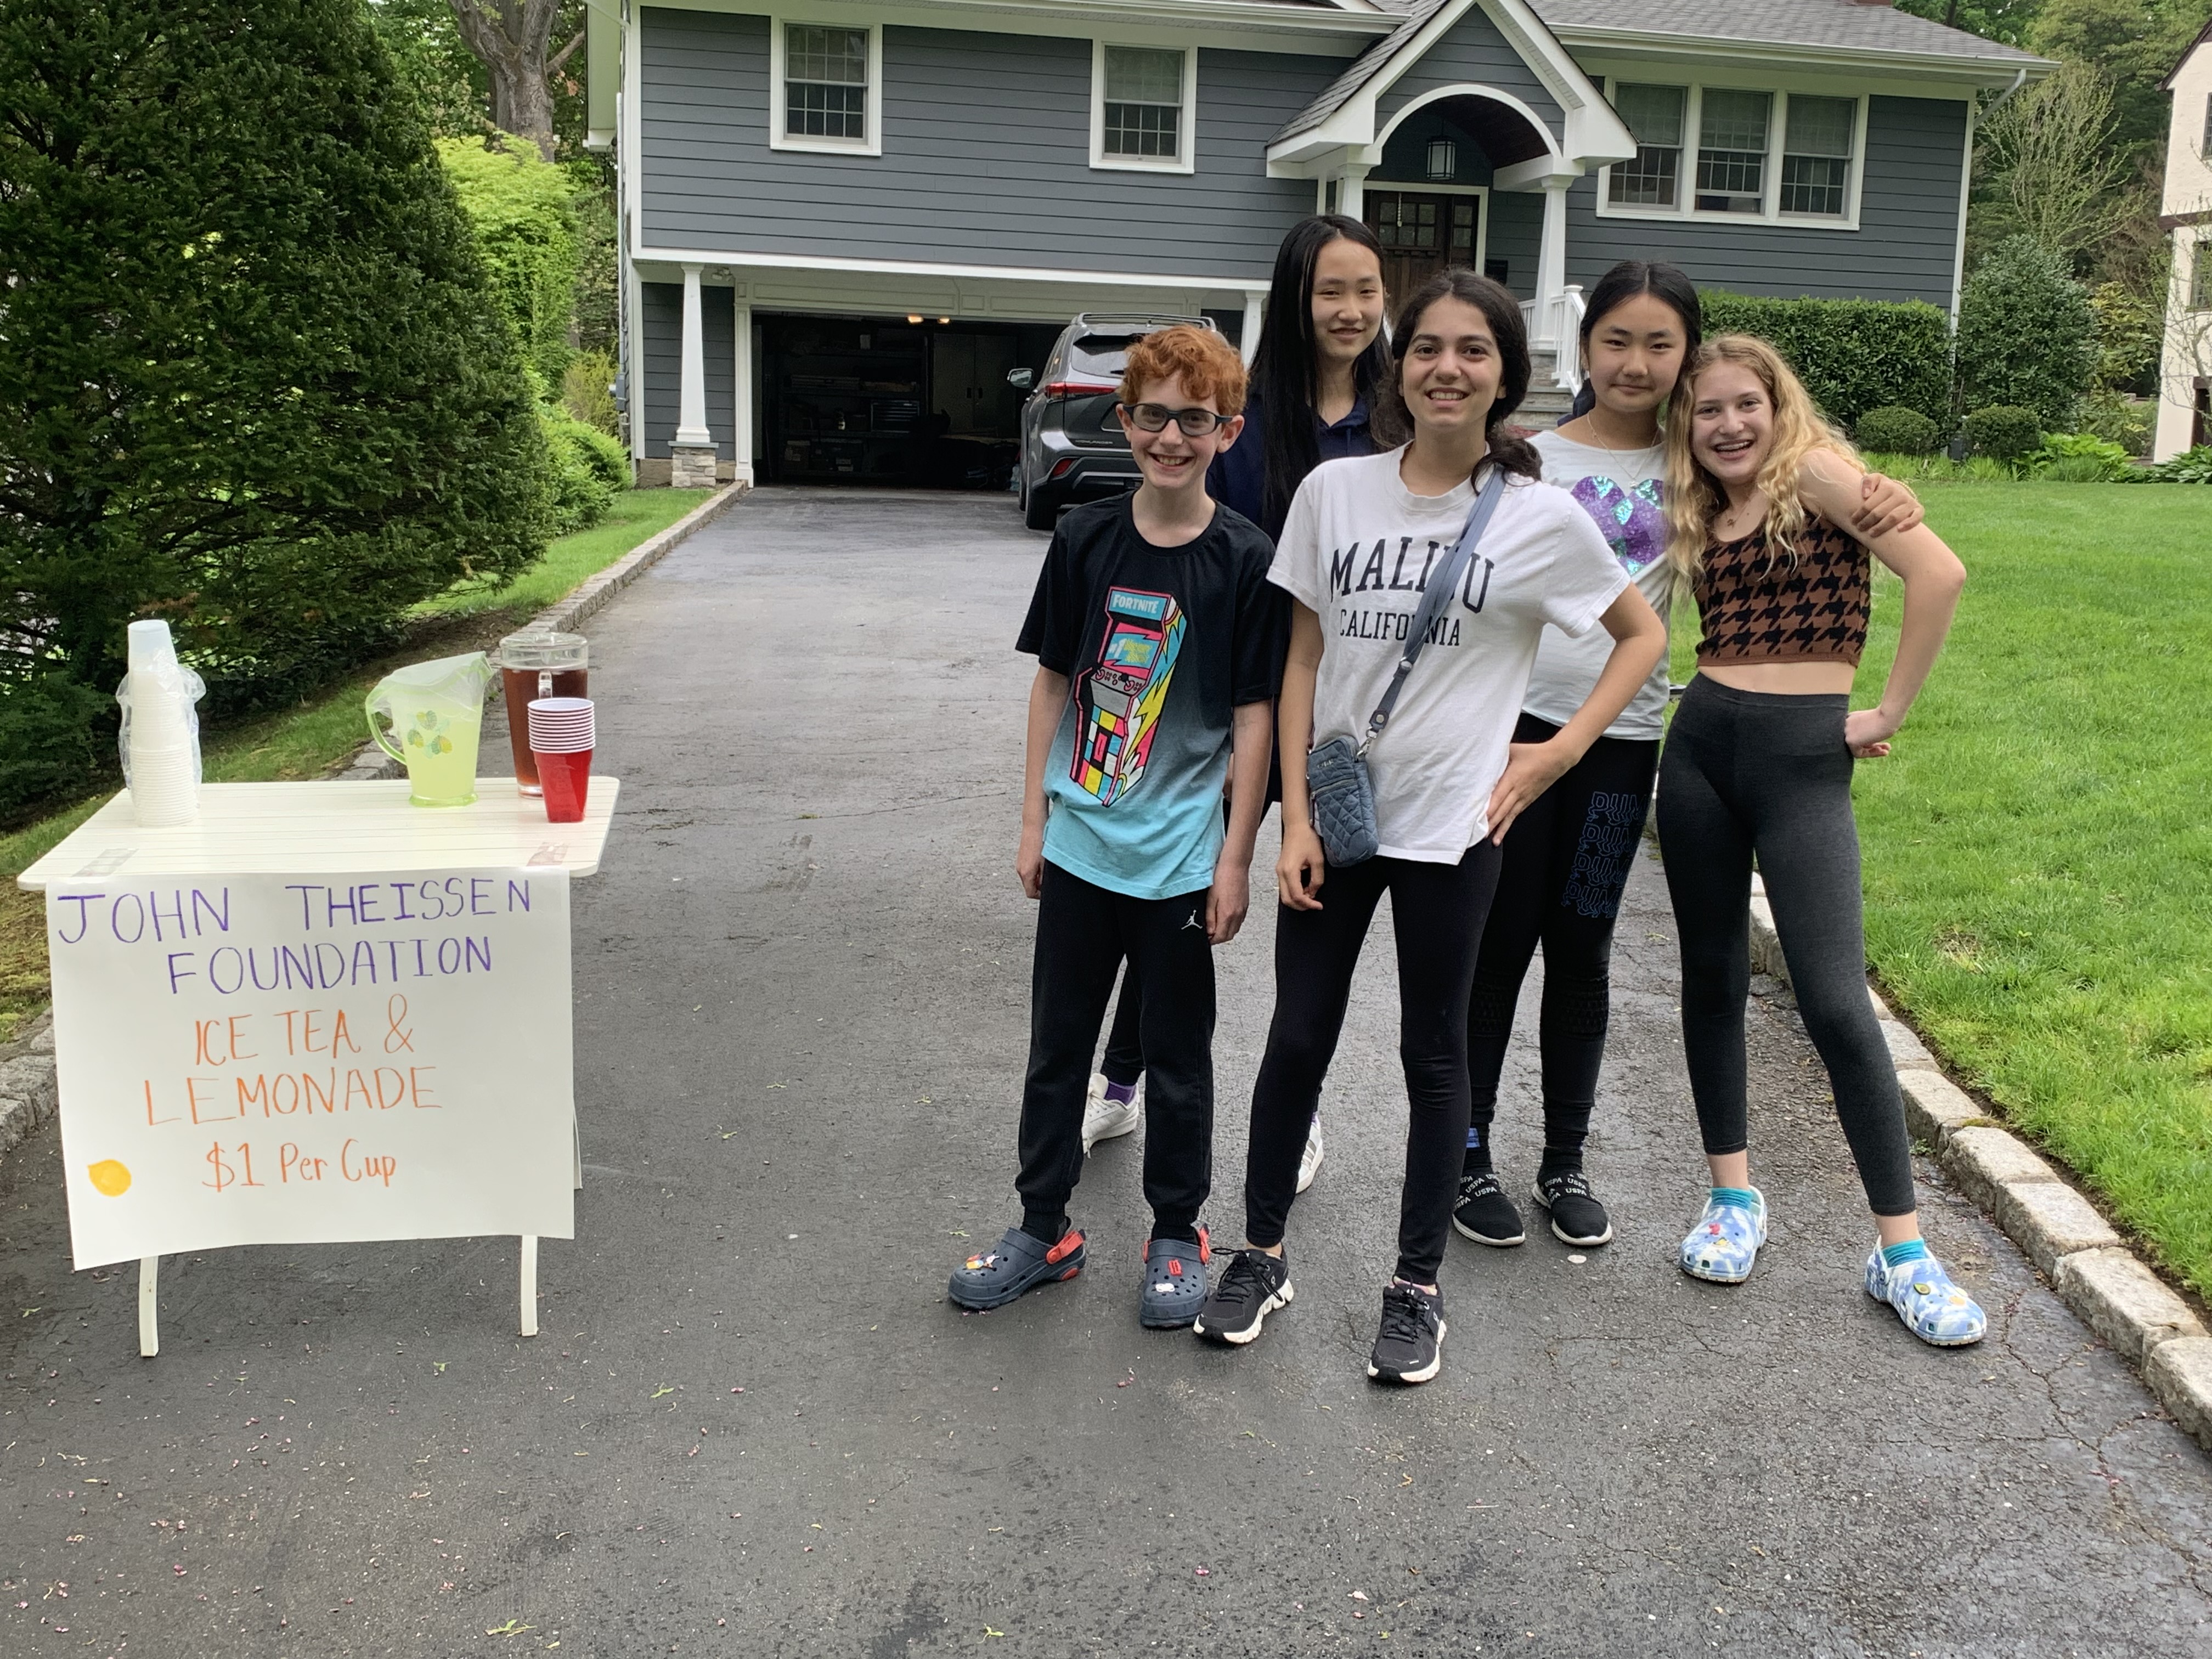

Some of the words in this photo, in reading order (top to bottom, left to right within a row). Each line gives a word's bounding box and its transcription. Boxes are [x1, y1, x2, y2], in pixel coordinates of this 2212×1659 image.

[1330, 536, 1494, 614] MALIU
[1112, 594, 1159, 614] FORTNITE
[1340, 609, 1460, 646] CALIFONIA
[57, 887, 229, 944] JOHN
[285, 878, 531, 930] THEISSEN
[167, 935, 492, 994] FOUNDATION
[195, 1014, 258, 1066] ICE
[273, 1009, 361, 1059] TEA
[384, 994, 415, 1053] &
[145, 1066, 443, 1126] LEMONADE
[202, 1142, 264, 1193] $1
[280, 1142, 329, 1183] Per
[341, 1138, 396, 1187] Cup
[1465, 1178, 1485, 1193] USPA
[1475, 1187, 1497, 1197] USPA
